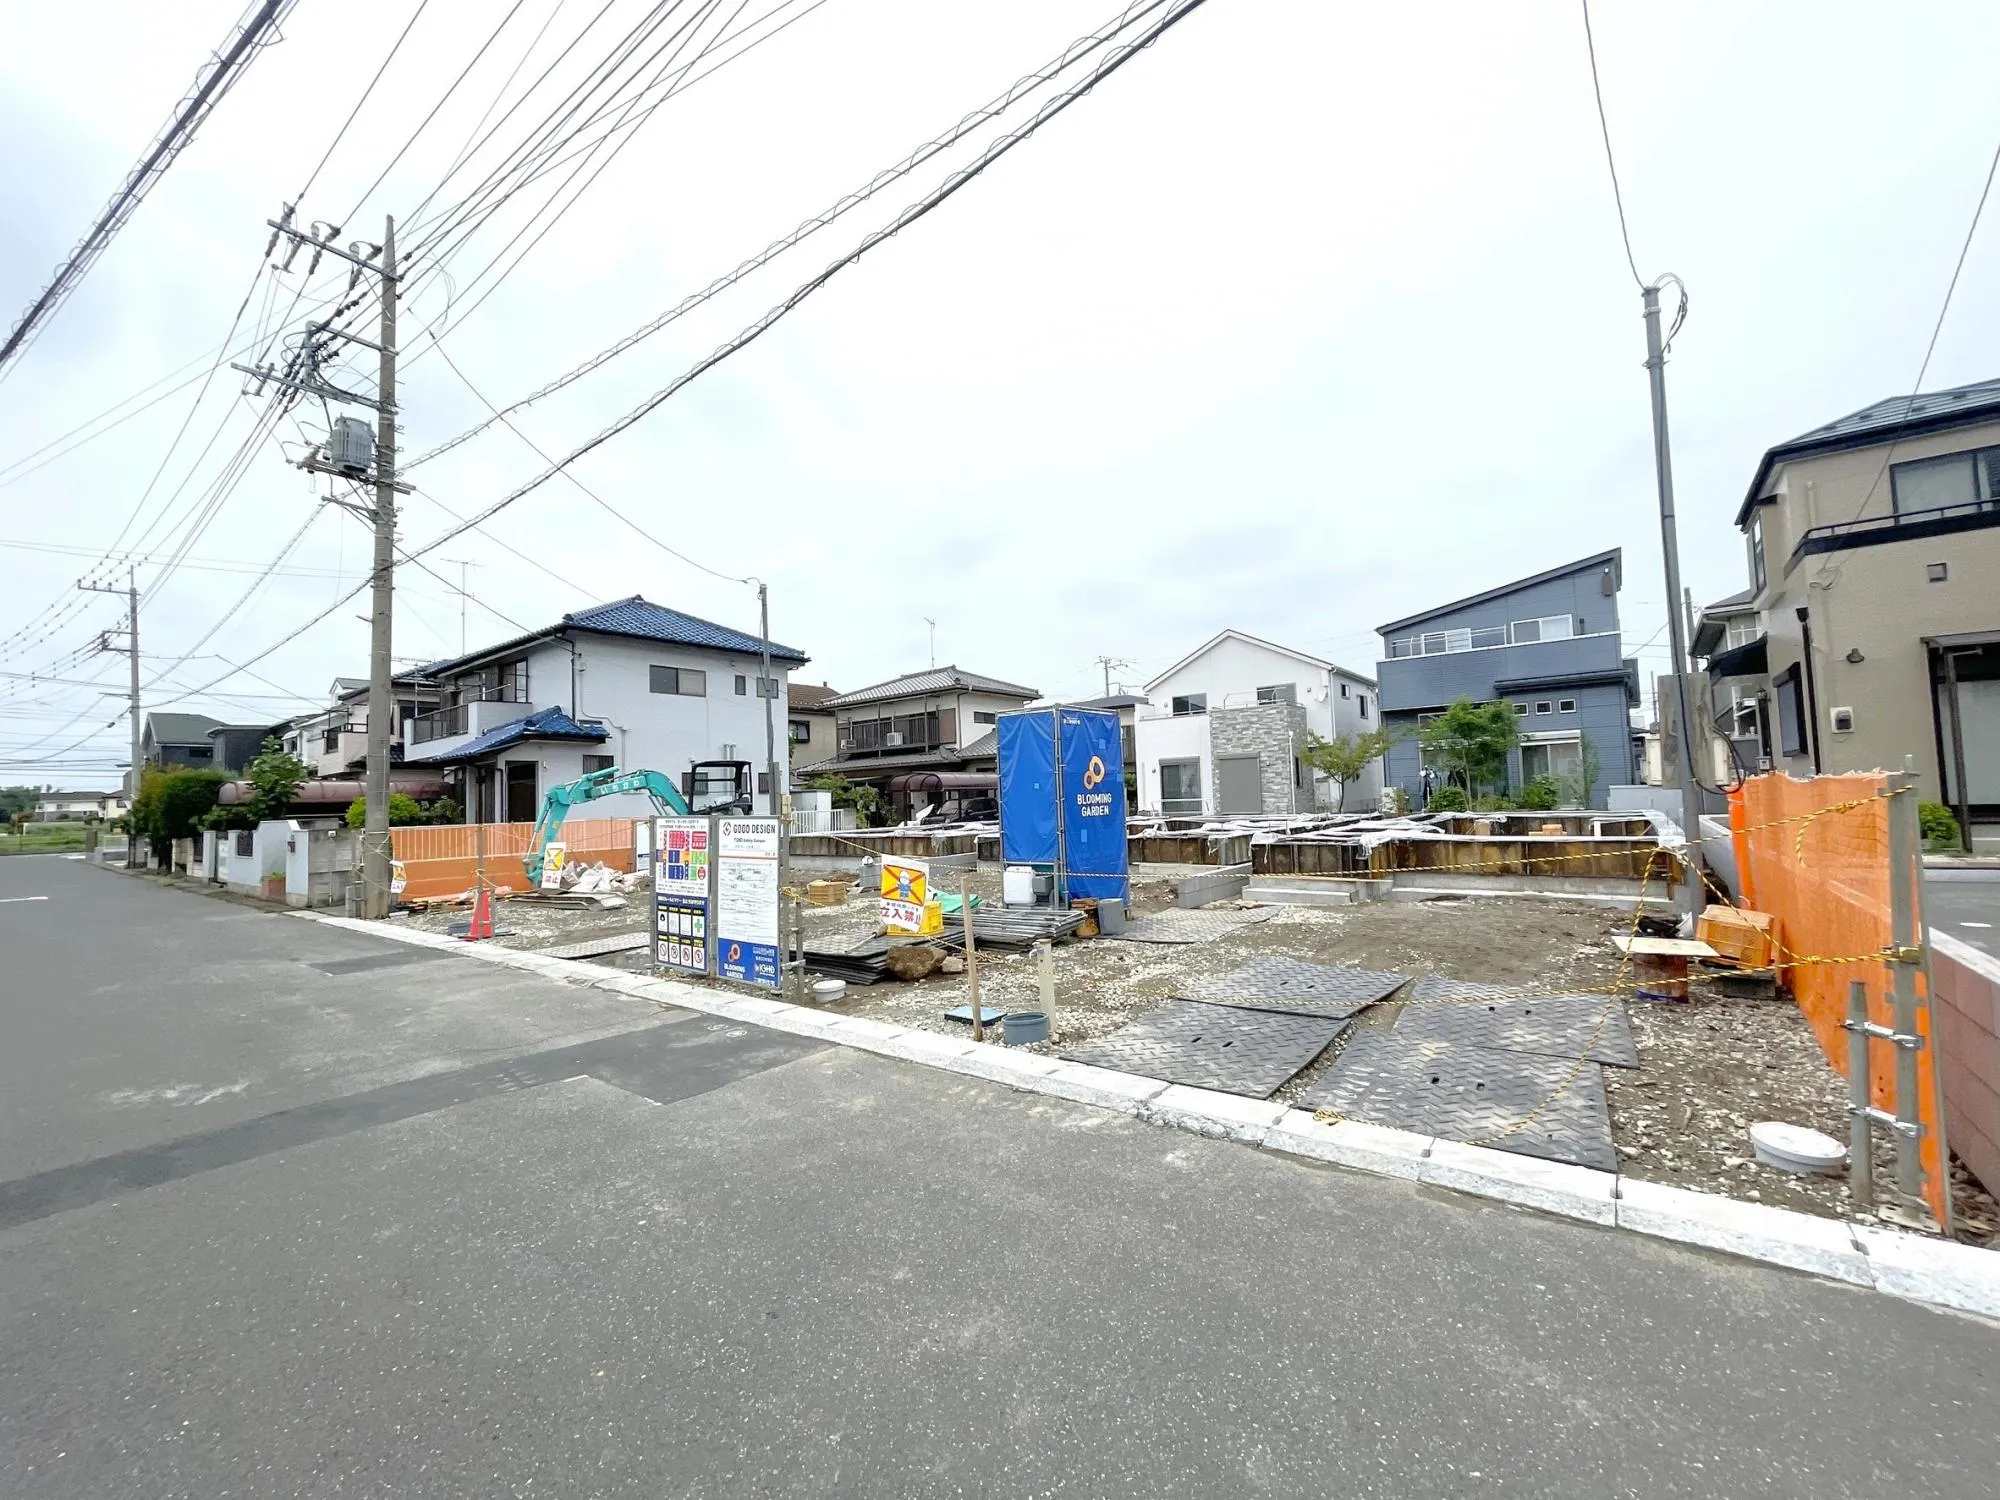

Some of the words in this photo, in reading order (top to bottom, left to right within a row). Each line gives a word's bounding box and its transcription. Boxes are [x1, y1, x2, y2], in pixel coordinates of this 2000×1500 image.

[1077, 792, 1112, 805] BLOOMING
[1081, 805, 1109, 817] GARDEN
[733, 823, 750, 834] GOOD
[751, 823, 776, 834] DESIGN
